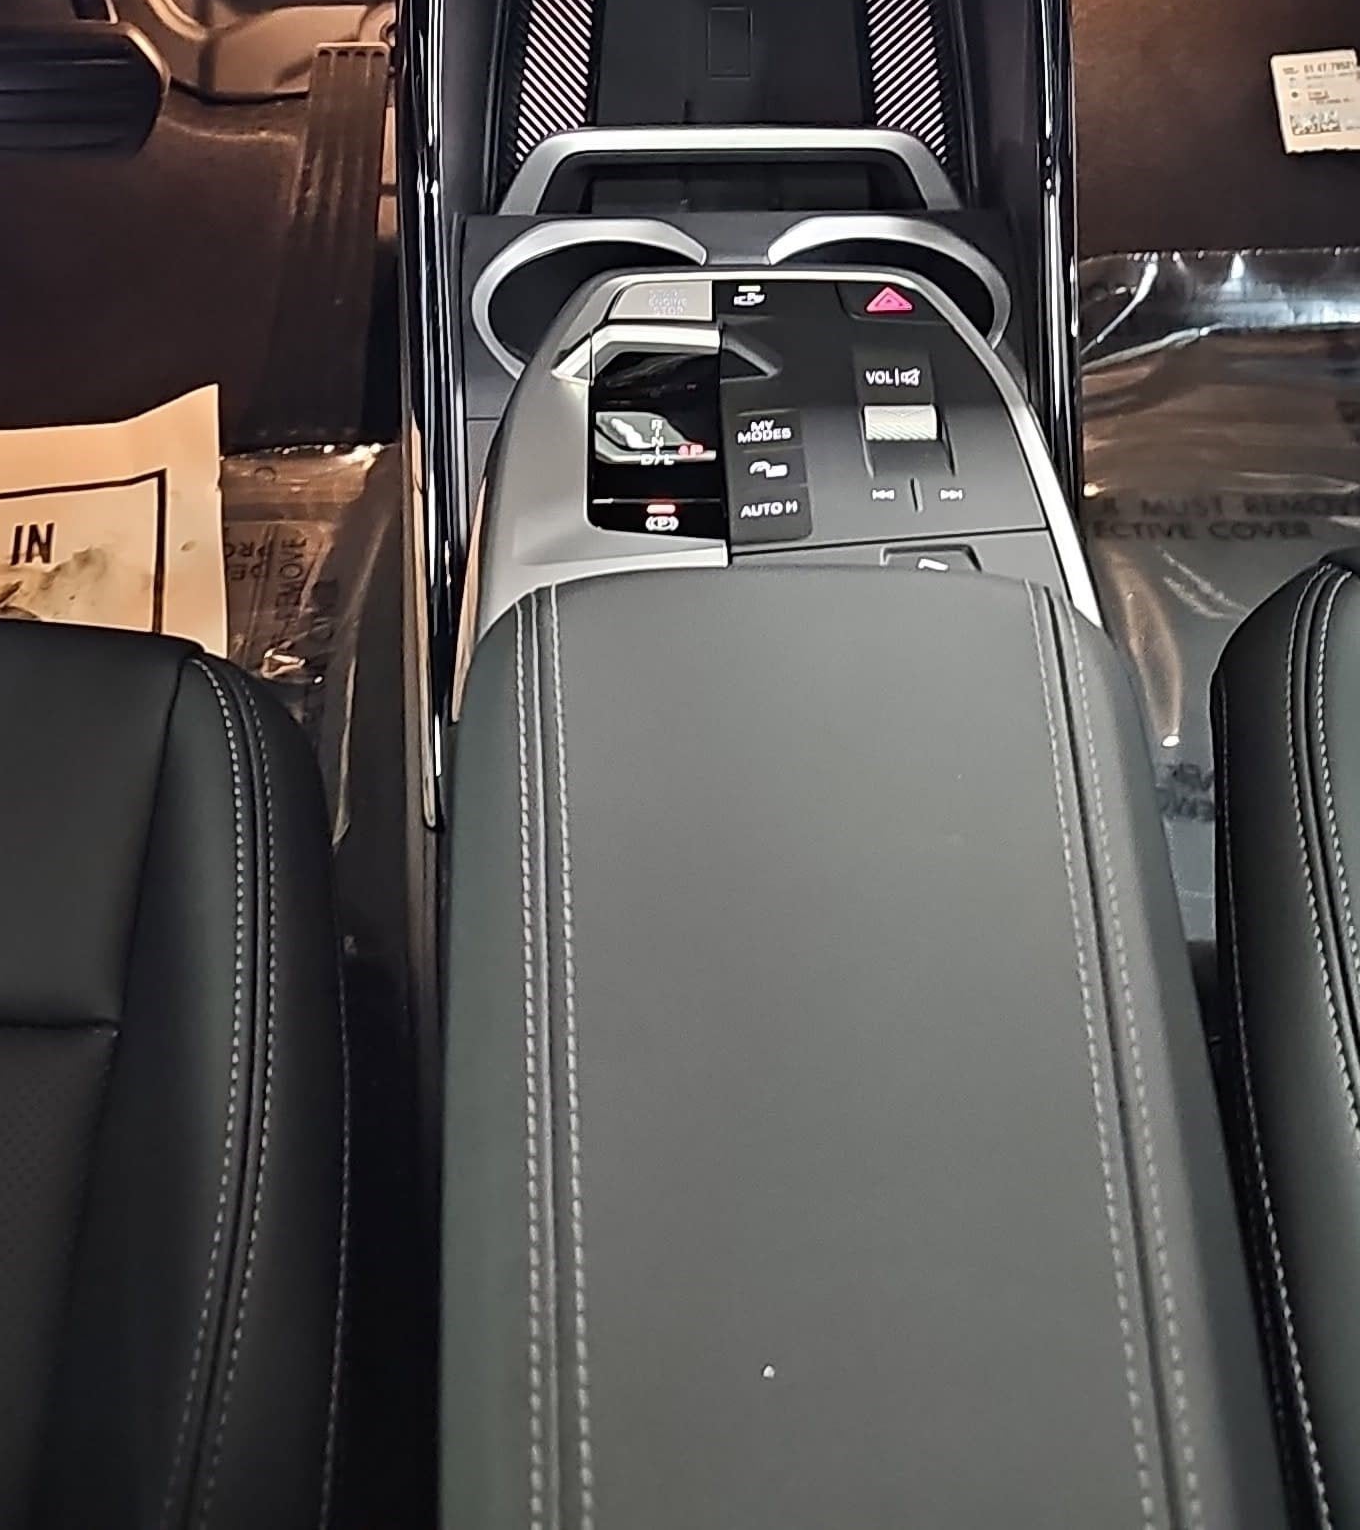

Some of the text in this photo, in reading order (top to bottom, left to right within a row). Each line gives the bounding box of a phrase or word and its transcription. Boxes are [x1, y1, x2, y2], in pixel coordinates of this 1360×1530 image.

[865, 370, 893, 384] VOL
[751, 420, 774, 432] MY
[738, 427, 791, 444] MODES
[740, 501, 784, 518] AUTO
[1207, 519, 1312, 541] COVER
[10, 522, 55, 566] IN
